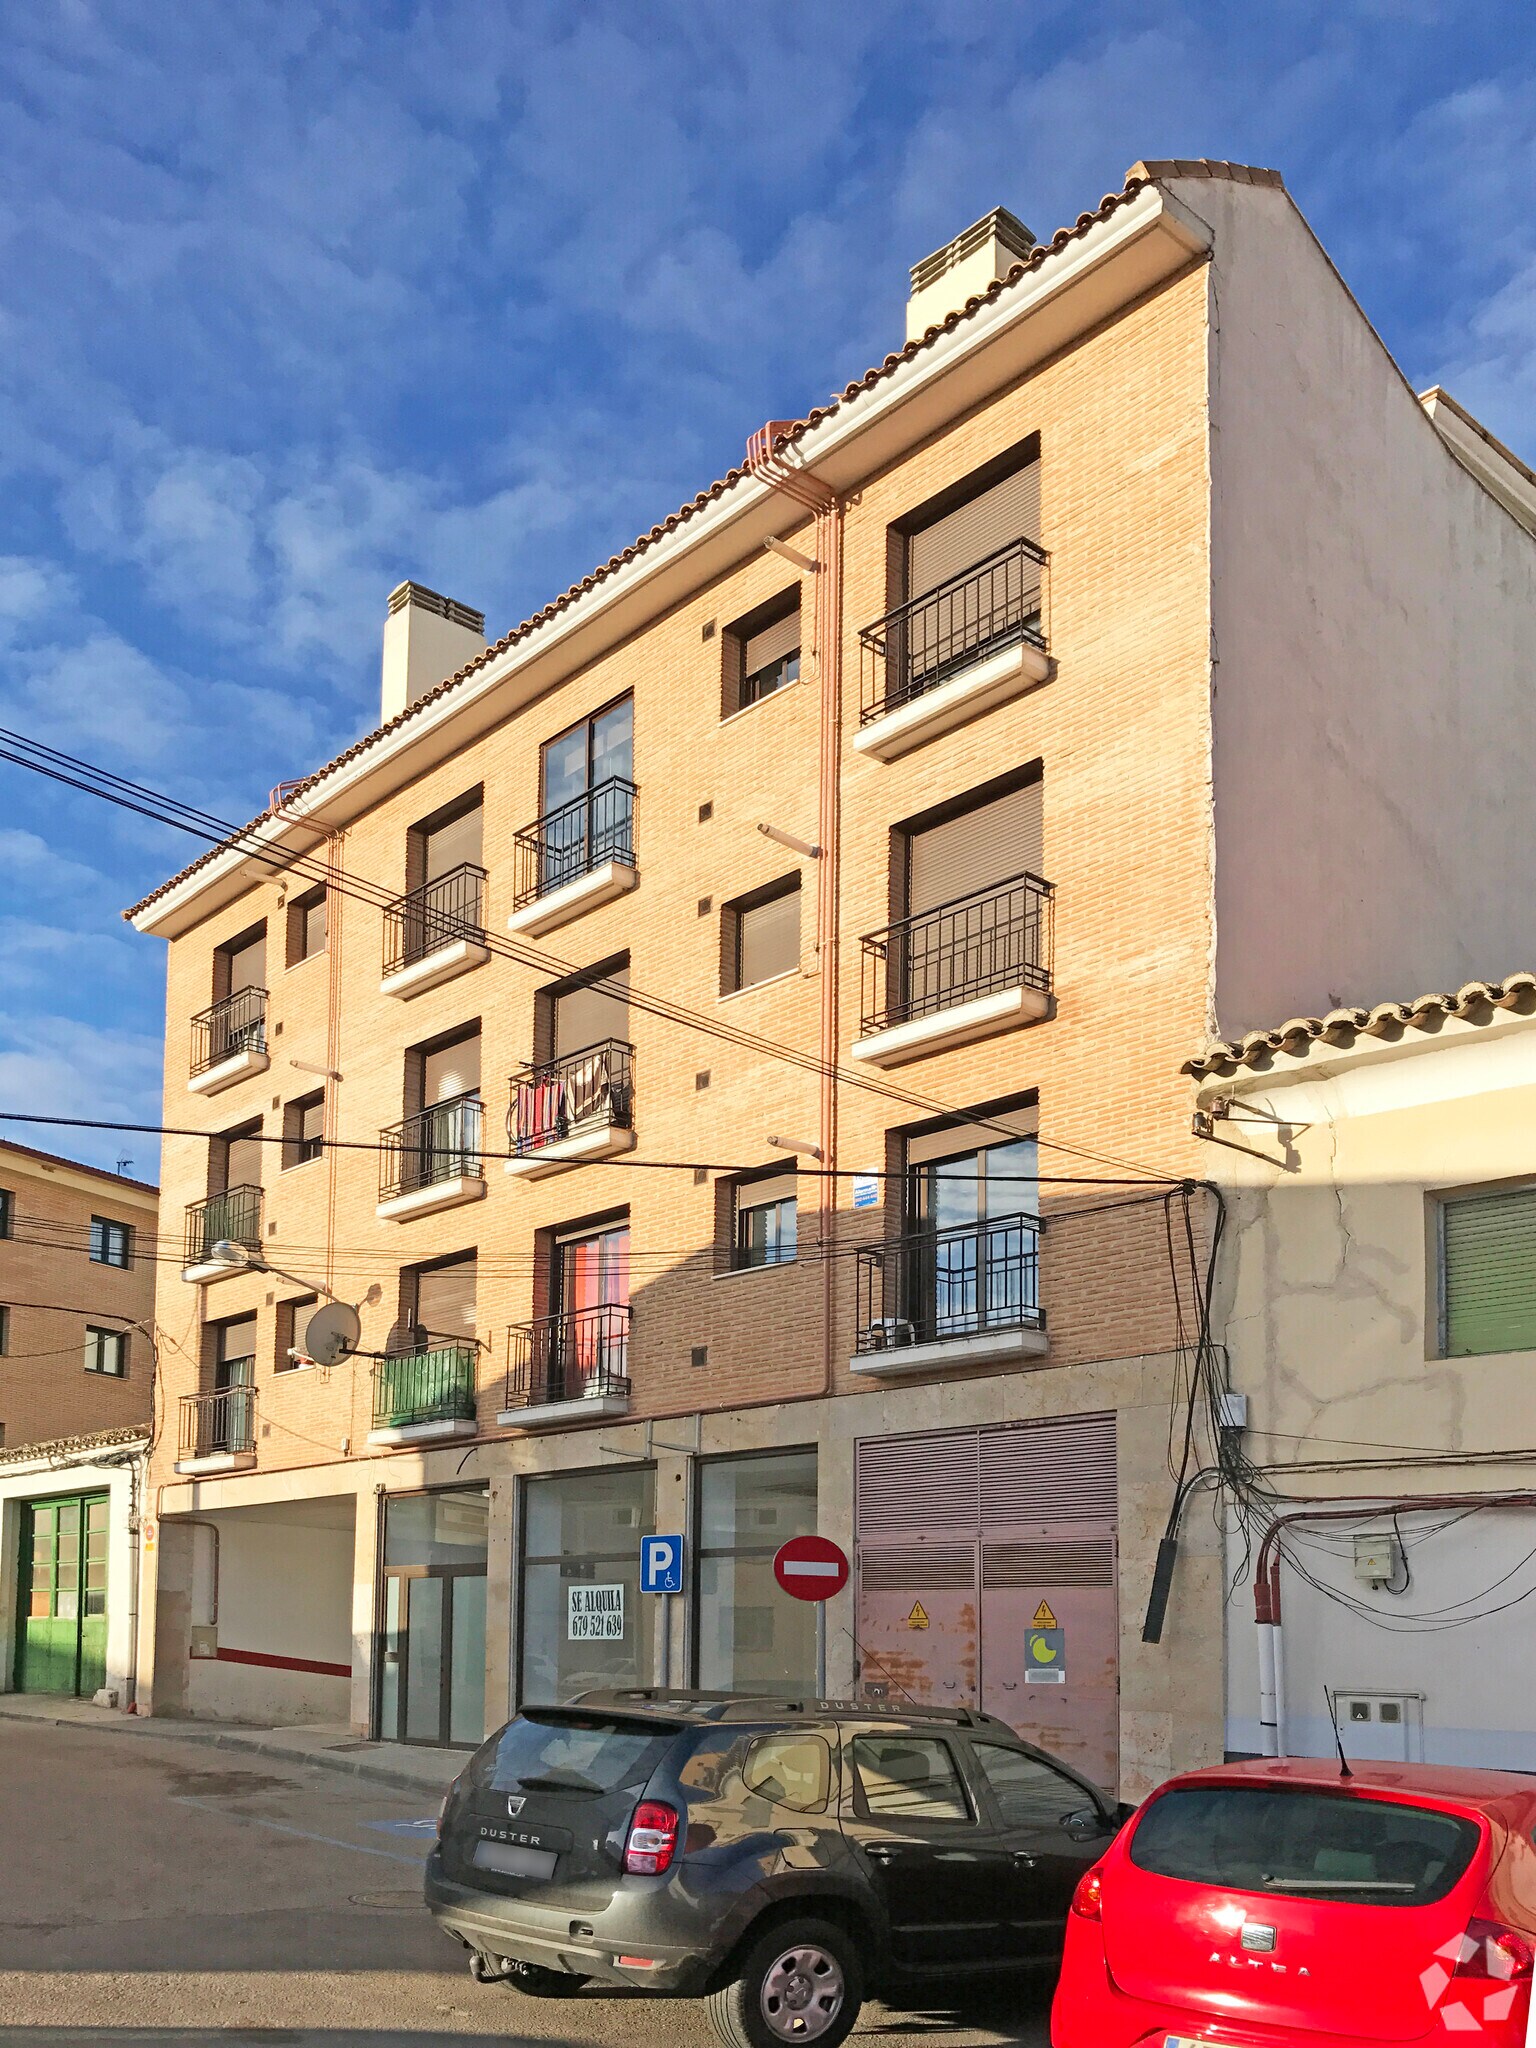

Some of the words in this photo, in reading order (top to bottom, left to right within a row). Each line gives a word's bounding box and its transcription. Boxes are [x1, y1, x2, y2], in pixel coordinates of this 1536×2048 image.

[649, 1542, 673, 1586] P
[572, 1591, 582, 1612] SE
[585, 1590, 621, 1614] ALQUILA
[572, 1615, 588, 1636] 679
[589, 1615, 605, 1636] 521
[606, 1615, 622, 1636] 639
[820, 1701, 901, 1712] DUSTER
[480, 1827, 541, 1845] DUSTER
[1208, 1951, 1311, 1977] ALTEA
